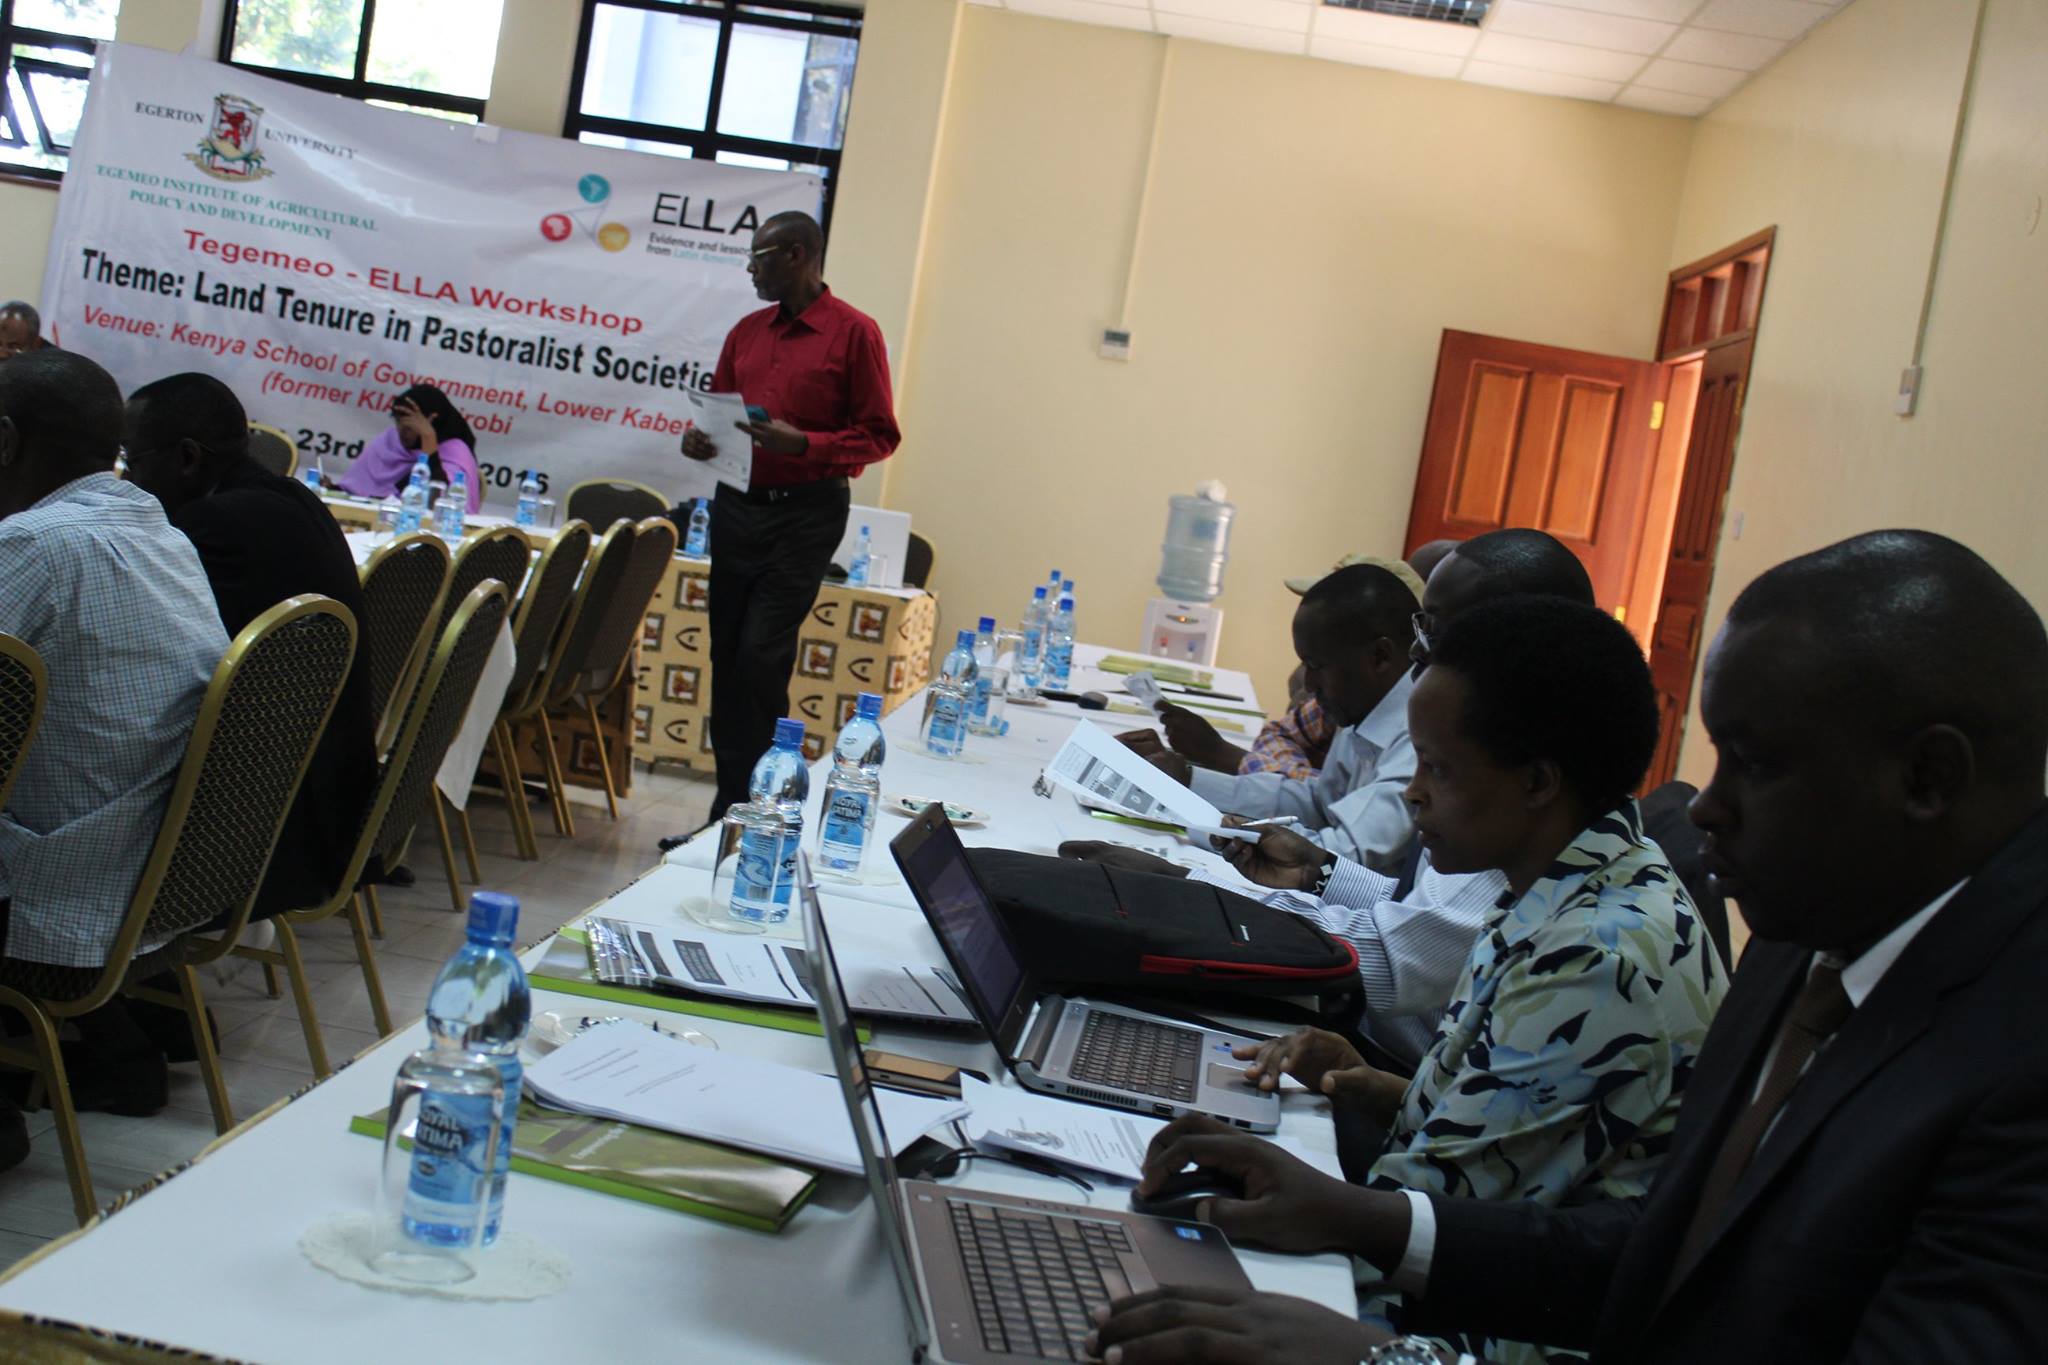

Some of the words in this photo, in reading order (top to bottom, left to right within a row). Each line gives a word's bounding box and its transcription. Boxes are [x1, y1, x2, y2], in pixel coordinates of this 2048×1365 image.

[135, 101, 205, 124] EGERTON
[265, 128, 358, 160] UNIVERSITY
[129, 188, 184, 211] POLICY
[186, 200, 218, 217] AND
[220, 207, 333, 241] DEVELOPMENT
[163, 176, 238, 202] INSTITUTE
[242, 192, 264, 207] OF
[266, 198, 379, 232] AGRICULTURAL
[653, 192, 759, 235] ELLA
[646, 243, 672, 257] from
[673, 247, 699, 260] Latin
[649, 232, 696, 249] Evidence
[697, 240, 718, 252] and
[183, 228, 335, 279] Tegemeo
[369, 267, 459, 303] ELLA
[470, 286, 644, 336] Workshop
[82, 248, 185, 298] Theme:
[194, 270, 266, 314] Land
[276, 286, 375, 335] Tenure
[384, 309, 412, 343] in
[421, 316, 584, 374] Pastoralist
[593, 345, 715, 392] Societie
[85, 304, 164, 338] Venue:
[170, 321, 246, 357] Kenya
[254, 339, 336, 373] School
[343, 359, 371, 378] of
[537, 392, 616, 423] Lower
[620, 406, 694, 435] Kabet
[261, 370, 353, 405] (former
[297, 428, 365, 460] 23rd
